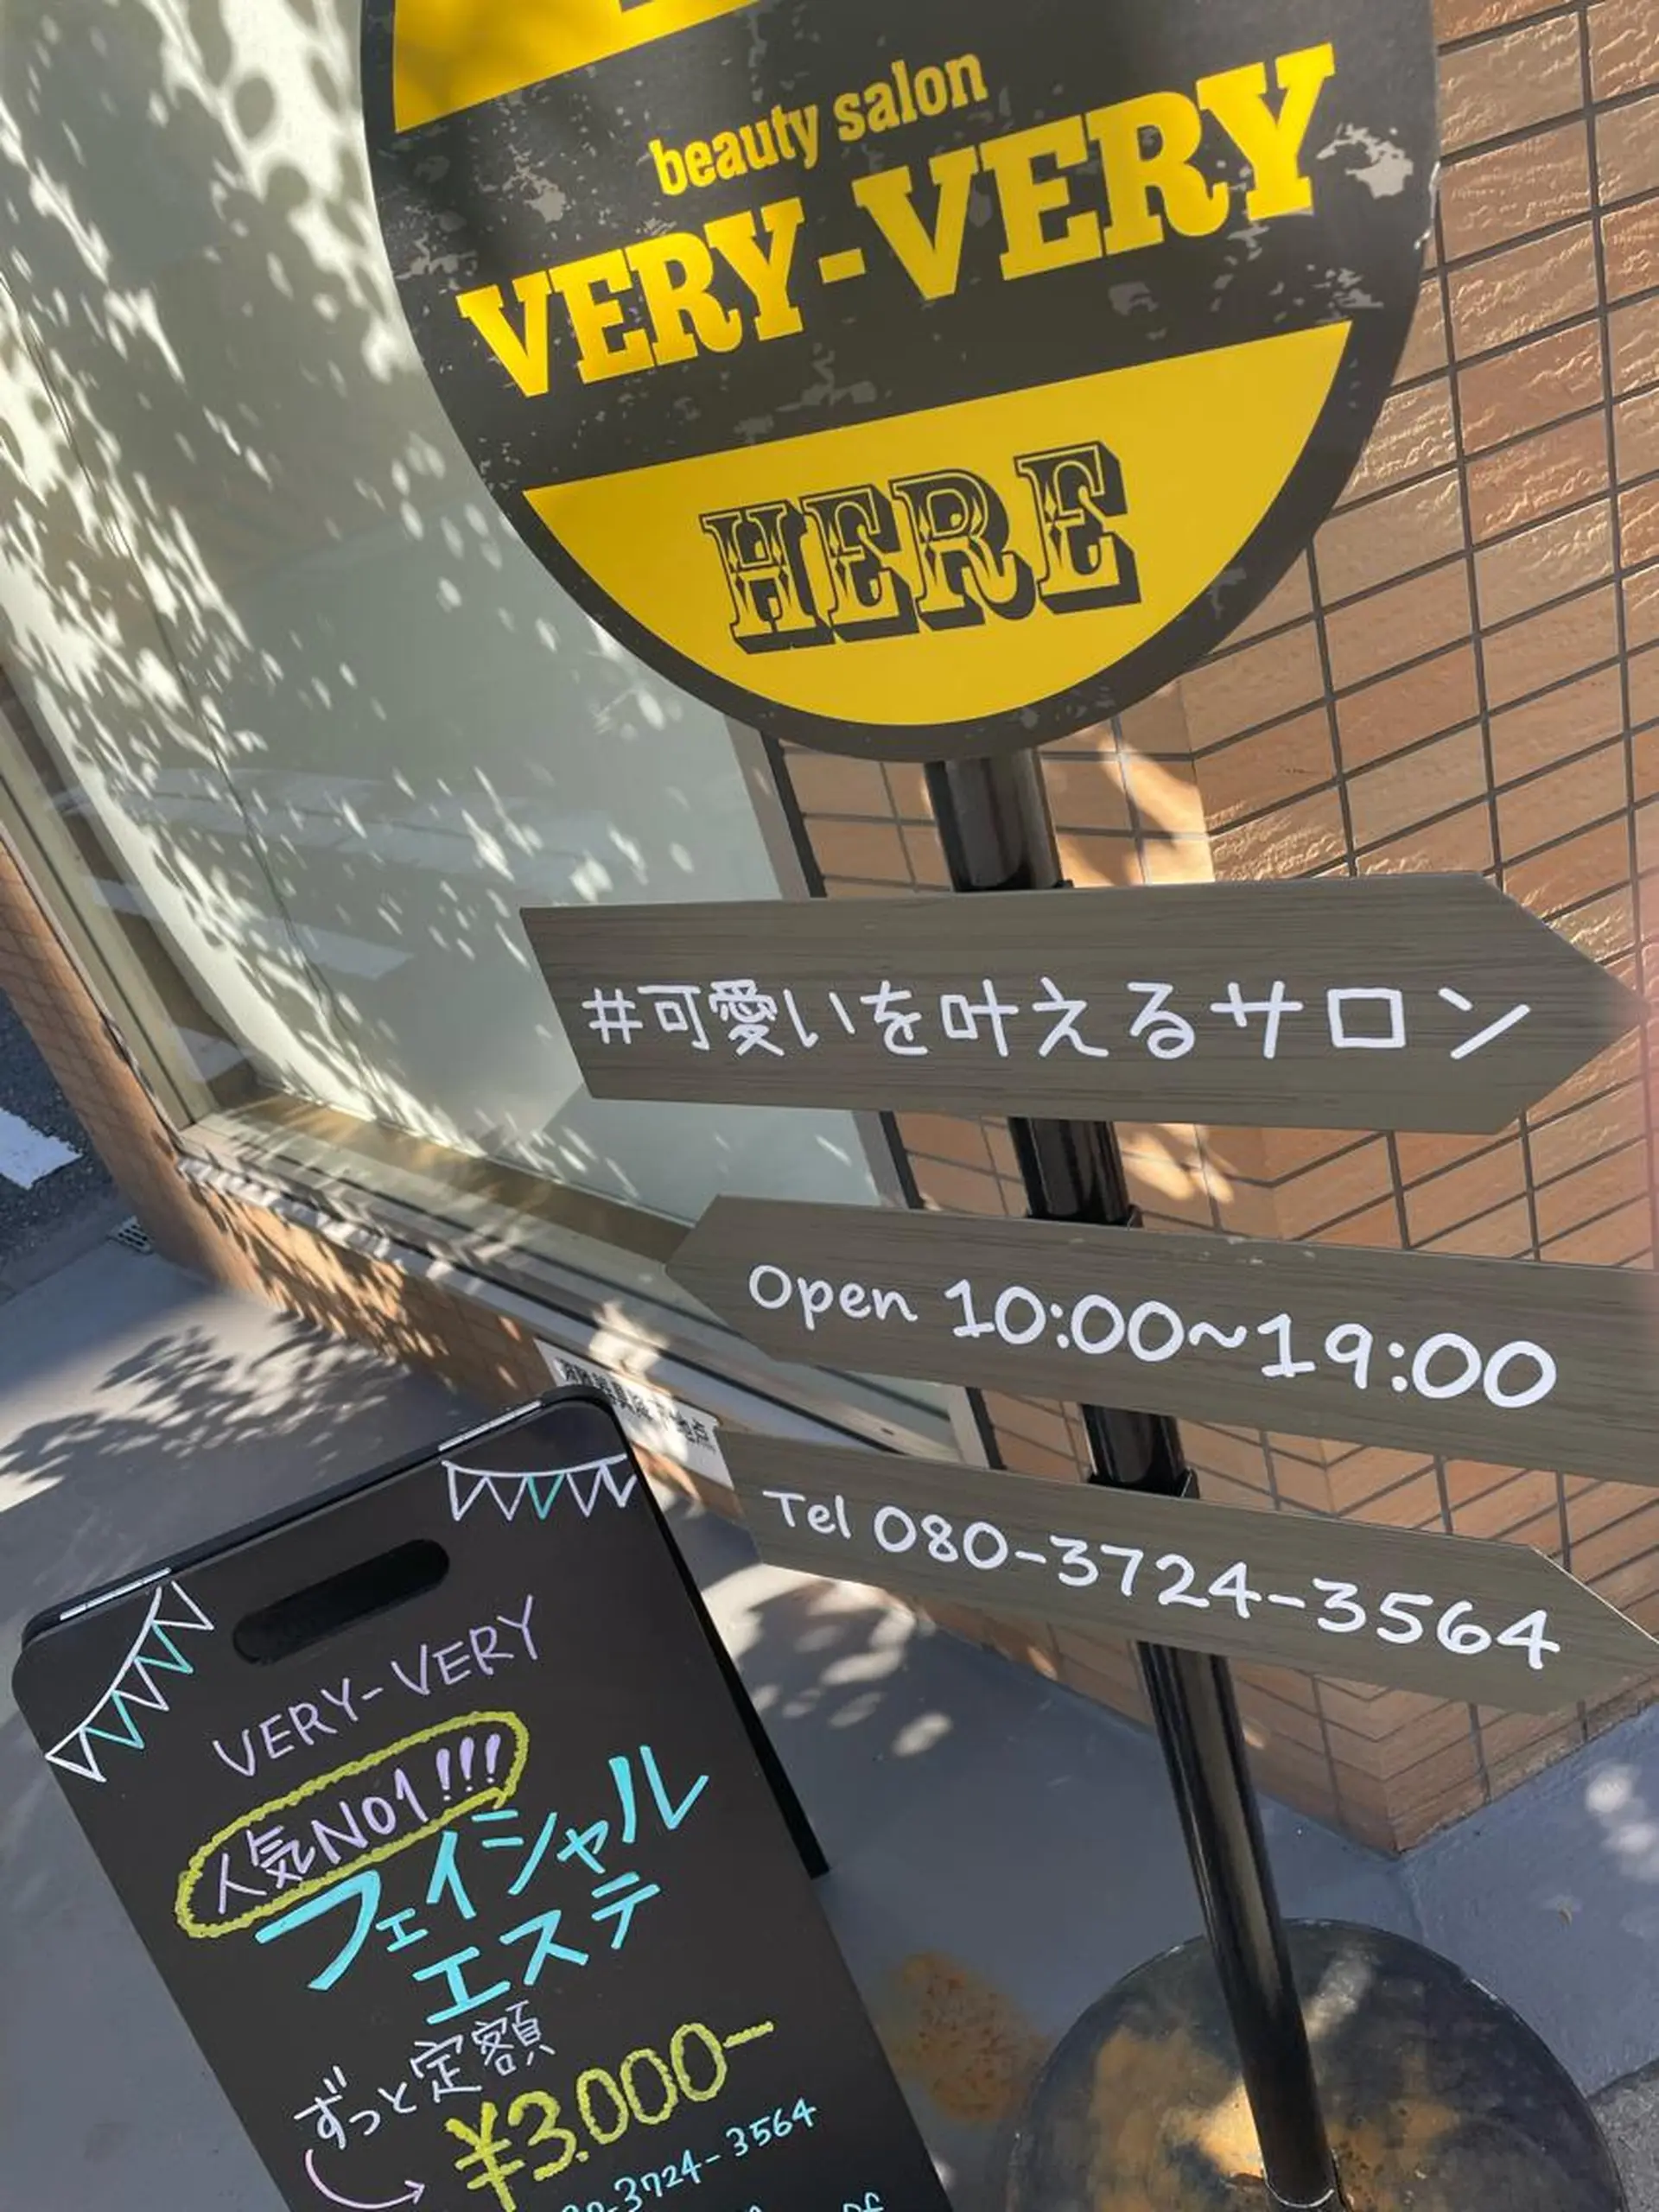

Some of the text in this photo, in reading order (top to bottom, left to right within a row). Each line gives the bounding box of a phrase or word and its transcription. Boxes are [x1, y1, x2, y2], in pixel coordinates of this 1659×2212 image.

[648, 54, 987, 196] beauty salon
[458, 42, 1336, 397] VERY-VERY
[702, 442, 1141, 653] HERE
[582, 977, 1530, 1060] #可愛いを叶えるサロン
[750, 1267, 918, 1331] Open
[763, 1491, 1560, 1669] Tel 080-3724-3564
[213, 1595, 537, 1777] VERY-VERY
[255, 1745, 709, 1990] フェイシャル
[412, 1872, 660, 2024] エステ
[294, 2000, 555, 2149] ずっと定額
